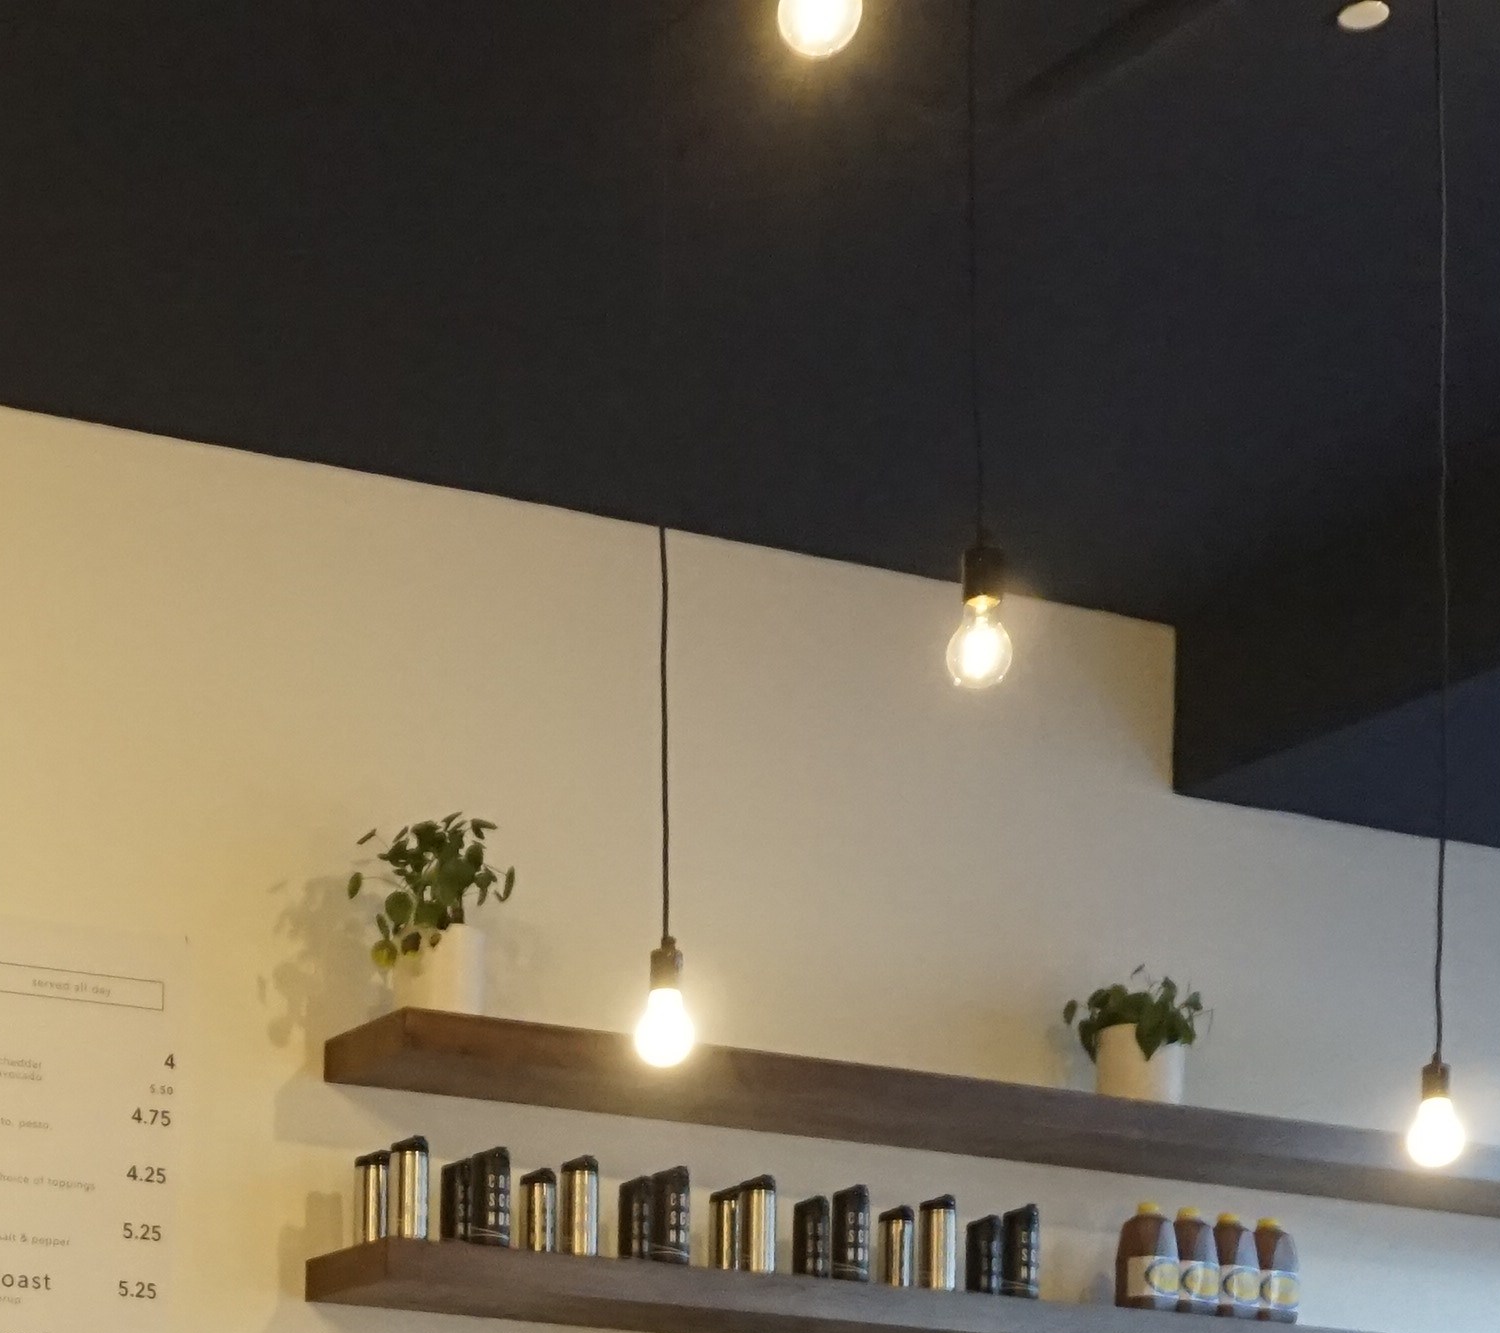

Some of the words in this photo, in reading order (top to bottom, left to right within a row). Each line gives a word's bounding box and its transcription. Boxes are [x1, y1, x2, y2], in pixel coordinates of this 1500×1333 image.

[164, 1053, 176, 1070] 4
[131, 1107, 172, 1128] 4.75
[126, 1165, 167, 1185] 4.25
[122, 1222, 162, 1243] 5.25
[118, 1279, 157, 1300] 5.25
